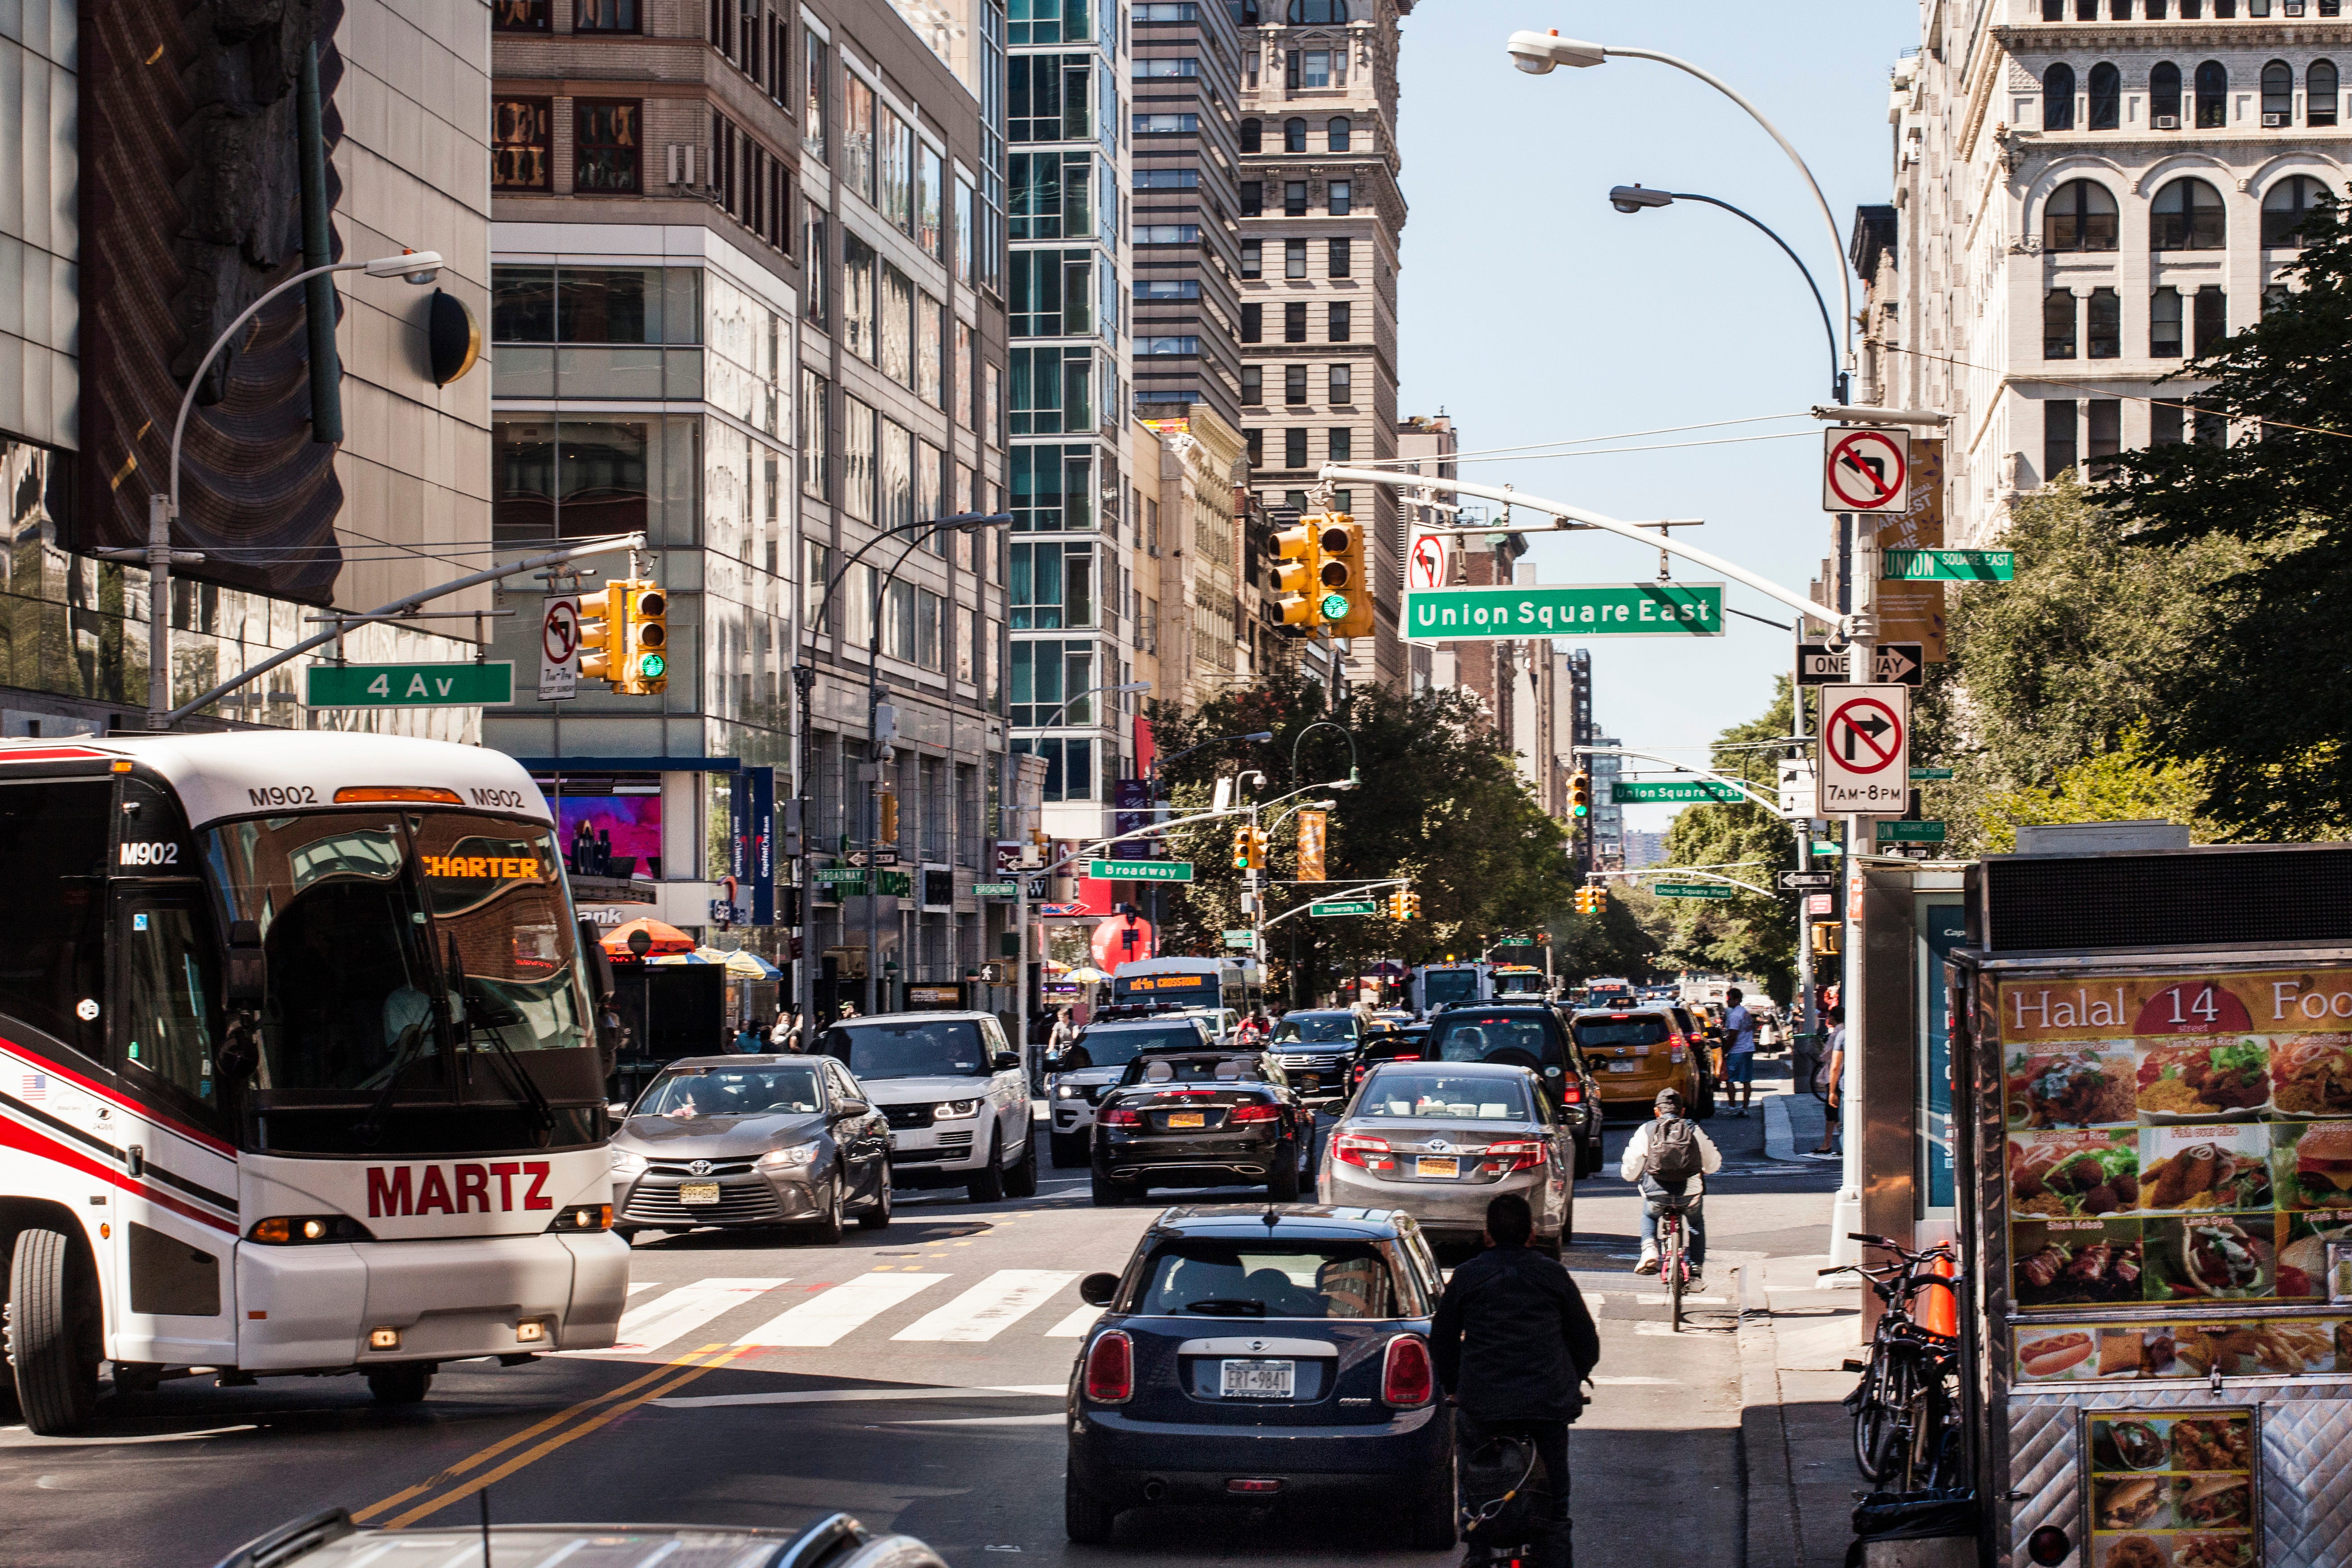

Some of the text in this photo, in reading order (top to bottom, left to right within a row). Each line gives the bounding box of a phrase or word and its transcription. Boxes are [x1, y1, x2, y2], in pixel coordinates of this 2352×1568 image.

[1877, 494, 1932, 533] AREST
[1899, 518, 1919, 536] IN
[1886, 552, 2009, 576] UNION SQUARE EAST
[1418, 598, 1710, 629] Union Square East
[1815, 657, 1904, 673] ONE AY
[367, 672, 454, 698] 4 Av
[248, 786, 318, 807] M902
[470, 788, 526, 808] M902
[1617, 787, 1740, 799] Union Square East
[1827, 784, 1901, 801] 7AM-8PM
[120, 842, 178, 865] M902
[817, 871, 862, 881] BROADWAY
[1105, 864, 1177, 879] Broadway
[976, 886, 1015, 894] BROADWAY
[1682, 887, 1709, 895] Square
[578, 908, 624, 924] ank
[2012, 987, 2127, 1029] Halal
[2166, 987, 2219, 1023] 14
[2177, 1024, 2209, 1033] street
[366, 1161, 553, 1218] MARTZ
